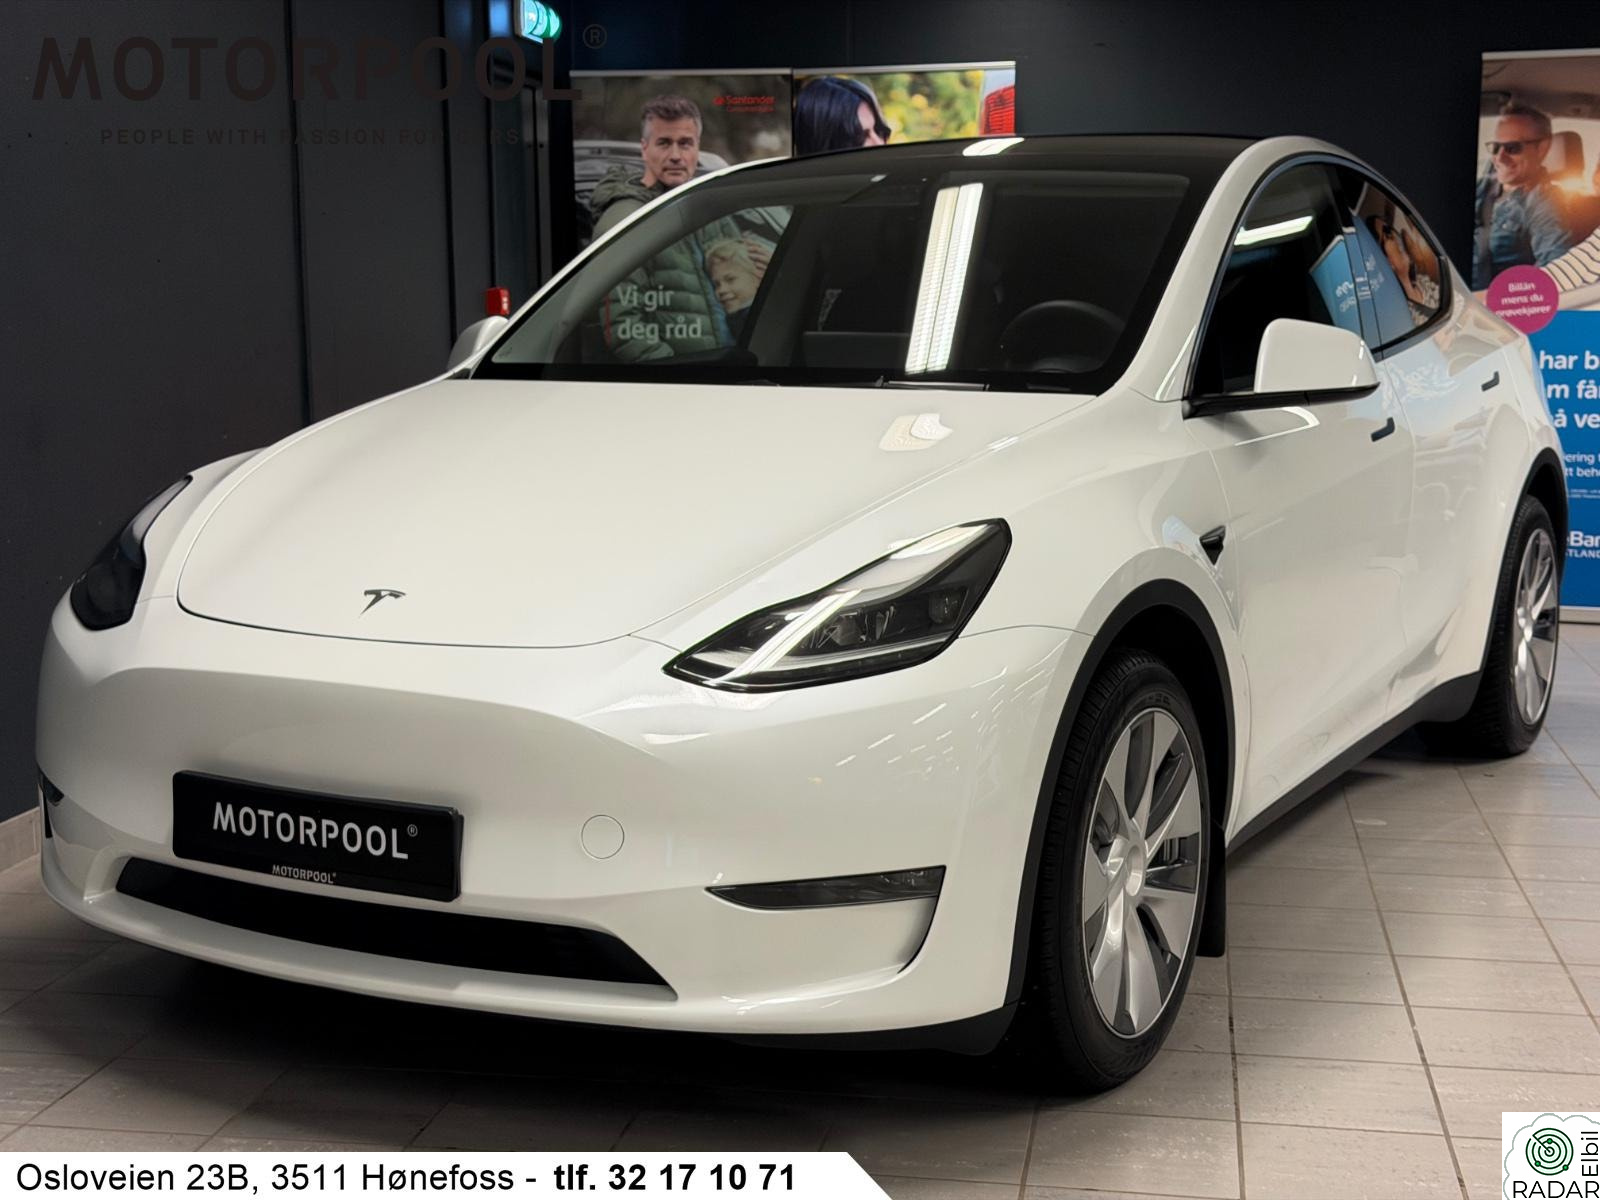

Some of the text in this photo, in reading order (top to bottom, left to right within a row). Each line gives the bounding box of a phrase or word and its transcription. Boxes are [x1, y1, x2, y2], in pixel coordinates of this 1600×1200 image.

[616, 285, 675, 312] Vi gir
[1501, 295, 1528, 305] mens
[617, 316, 702, 344] deg råd
[1540, 350, 1579, 370] har
[1577, 379, 1600, 399] få
[1564, 451, 1596, 466] ering
